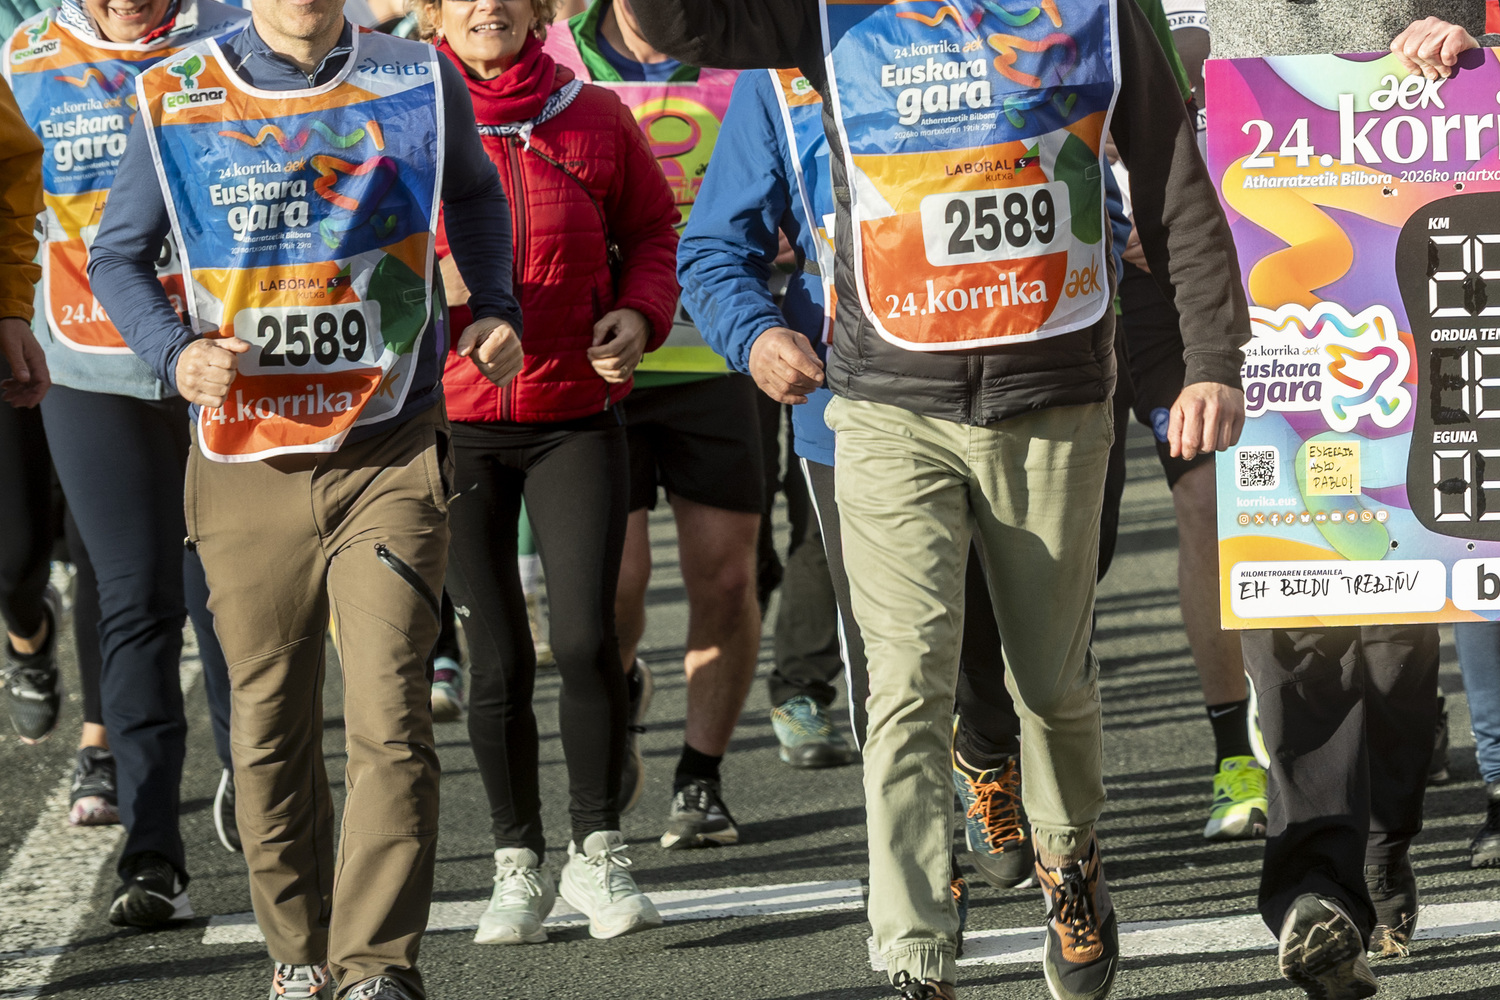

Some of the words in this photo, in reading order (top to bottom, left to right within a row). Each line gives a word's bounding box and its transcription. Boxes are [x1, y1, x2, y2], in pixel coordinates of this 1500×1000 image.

[894, 40, 959, 59] 24.korrika
[962, 35, 984, 52] aek
[381, 60, 429, 76] eitb
[881, 56, 987, 88] Euskara
[167, 89, 224, 107] goiener
[896, 79, 992, 126] gara
[1369, 74, 1447, 112] aek
[50, 99, 103, 115] 24.korrika
[39, 113, 124, 139] Euskara
[920, 114, 968, 126] Atharratzetik
[969, 111, 996, 121] Bilbora
[920, 126, 961, 137] martxoaren
[962, 124, 979, 132] 19tik
[980, 122, 997, 131] 29ra
[54, 132, 127, 171] gara
[219, 162, 281, 180] 24.korrika
[283, 157, 307, 174] aek
[945, 159, 1012, 177] LABORAL
[985, 172, 1014, 182] kutxa
[1243, 171, 1338, 189] Atharratzetik
[1340, 171, 1392, 187] Bilbora
[1400, 169, 1449, 183] 2026ko
[209, 177, 307, 206] Euskara
[227, 200, 309, 241] gara
[945, 188, 1056, 256] 2589
[1428, 217, 1450, 230] KM
[285, 230, 311, 240] Bilbora
[260, 278, 324, 292] LABORAL
[1065, 254, 1101, 298] aek
[885, 272, 1049, 319] 24.korrika
[257, 309, 367, 367] 2589
[1430, 328, 1477, 342] ORDUA
[1246, 345, 1300, 357] 24.korrika
[1246, 380, 1322, 411] gara
[1432, 430, 1478, 444] EGUNA
[1313, 474, 1353, 494] PABLO!
[1236, 497, 1297, 508] korrika.eus
[1240, 570, 1301, 578] KILOMETROAREN
[1302, 569, 1343, 577] ERAMAILEA
[1238, 580, 1270, 600] EH
[1280, 578, 1330, 597] BILDU
